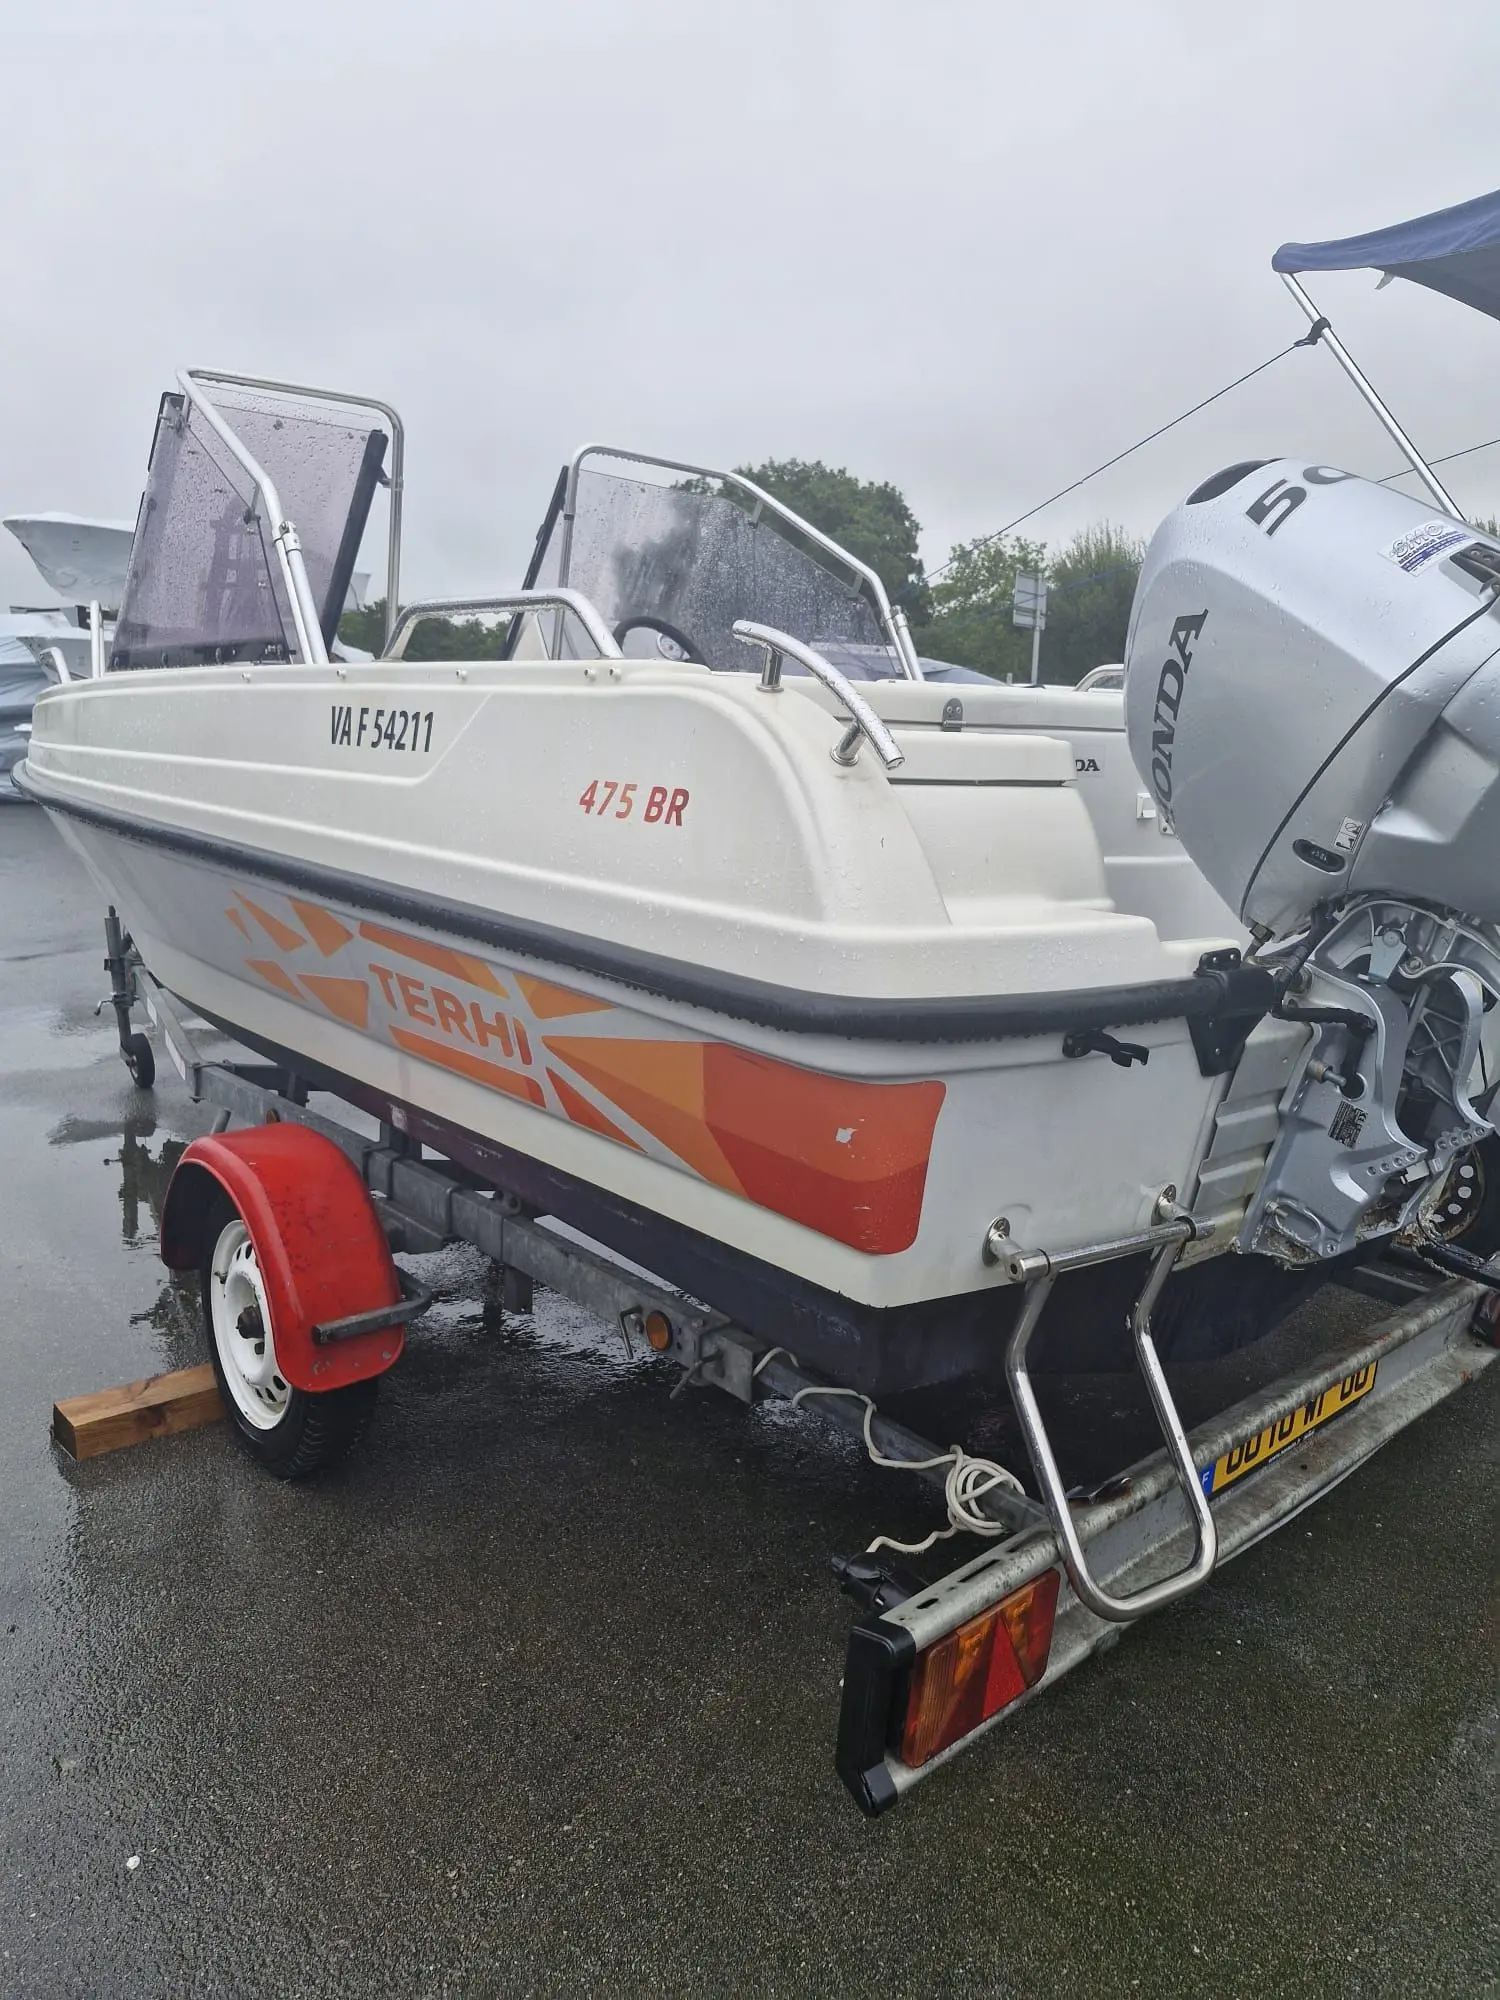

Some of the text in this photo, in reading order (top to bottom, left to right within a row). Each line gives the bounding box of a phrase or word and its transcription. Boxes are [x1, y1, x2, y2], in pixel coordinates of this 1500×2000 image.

[331, 705, 352, 746] VA
[1152, 608, 1209, 806] ONDA
[1074, 758, 1101, 772] DA
[579, 779, 690, 827] 475 BR
[368, 962, 533, 1066] TERHI
